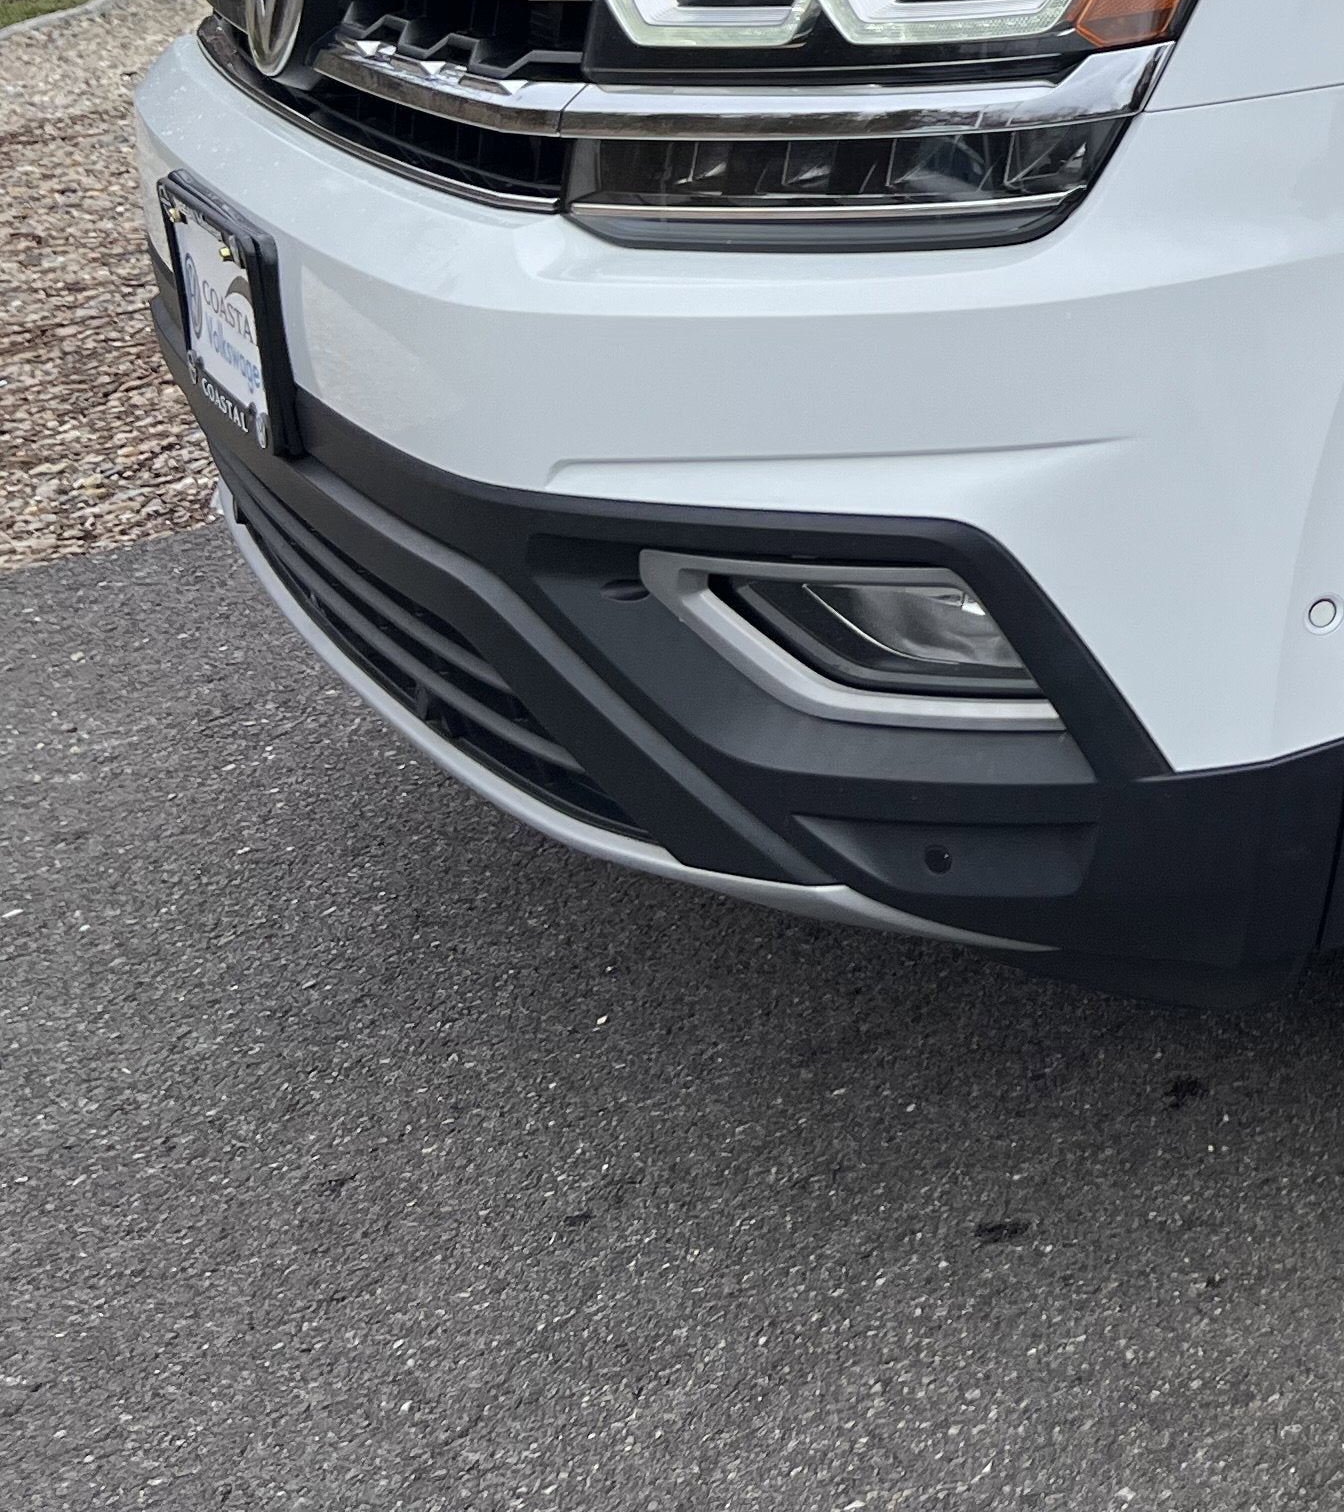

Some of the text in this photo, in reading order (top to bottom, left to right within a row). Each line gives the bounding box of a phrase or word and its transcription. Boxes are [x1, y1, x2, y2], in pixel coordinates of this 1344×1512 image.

[201, 279, 256, 345] COASTA
[205, 311, 261, 394] Volkswage
[201, 376, 249, 433] COASTAL
